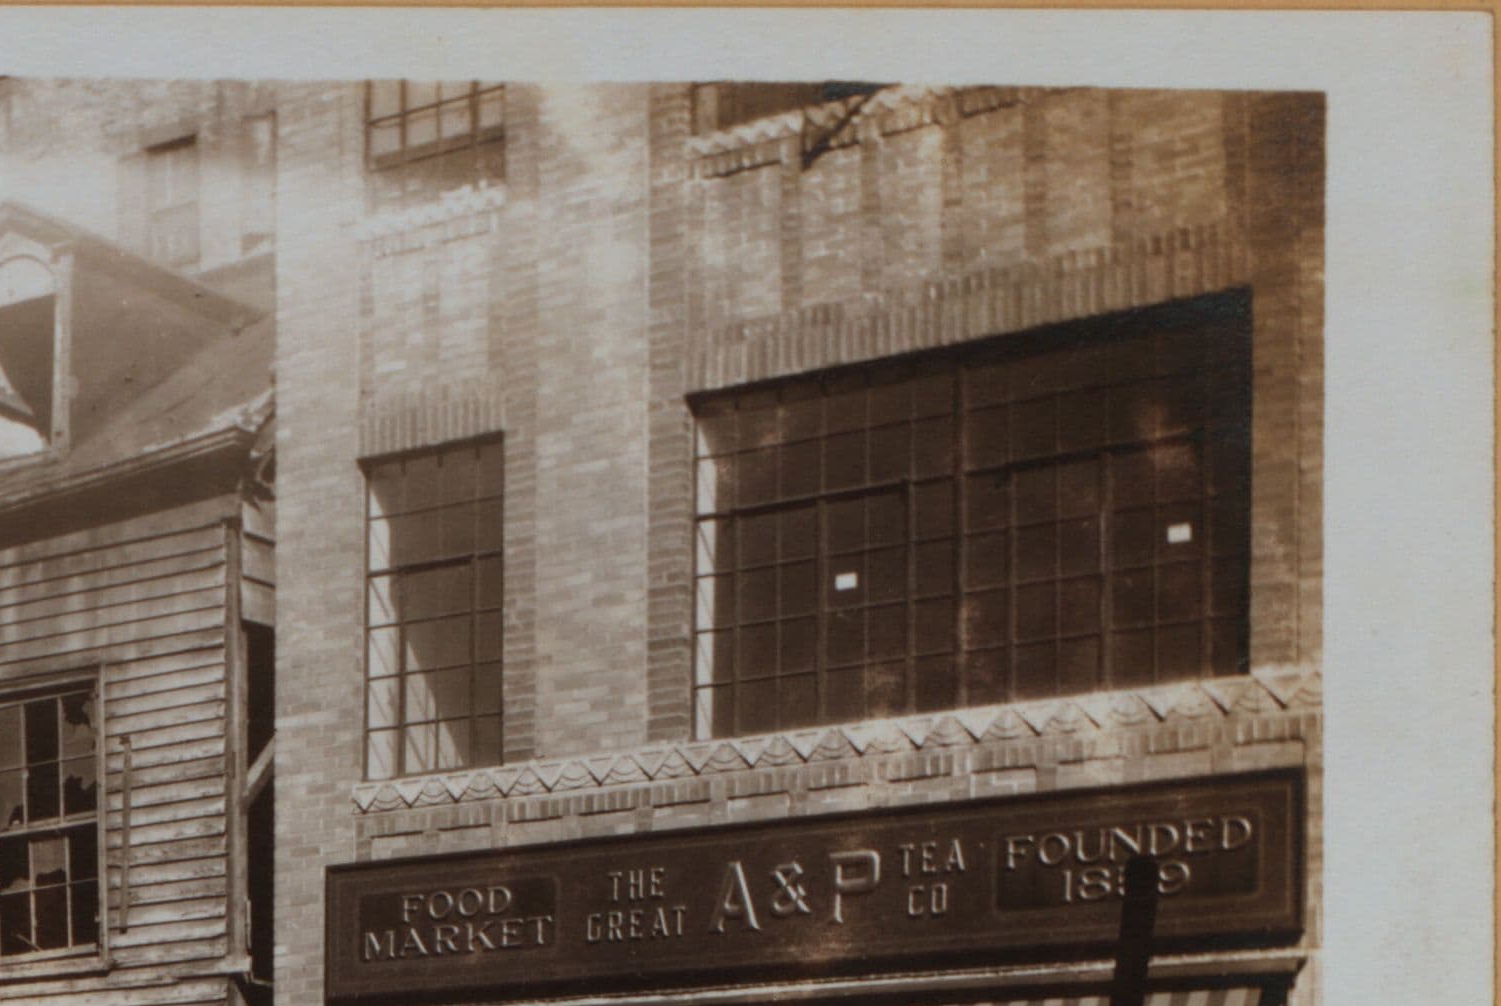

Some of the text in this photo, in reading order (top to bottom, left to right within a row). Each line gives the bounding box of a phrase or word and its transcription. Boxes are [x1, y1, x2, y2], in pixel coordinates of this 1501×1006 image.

[901, 838, 966, 877] TEA
[1006, 816, 1252, 870] FOUNDED
[607, 866, 666, 902] THE
[907, 883, 948, 917] CO
[1061, 860, 1192, 902] 189
[401, 885, 513, 926] FOOD
[586, 905, 688, 943] GREAT
[363, 914, 553, 961] MARKET
